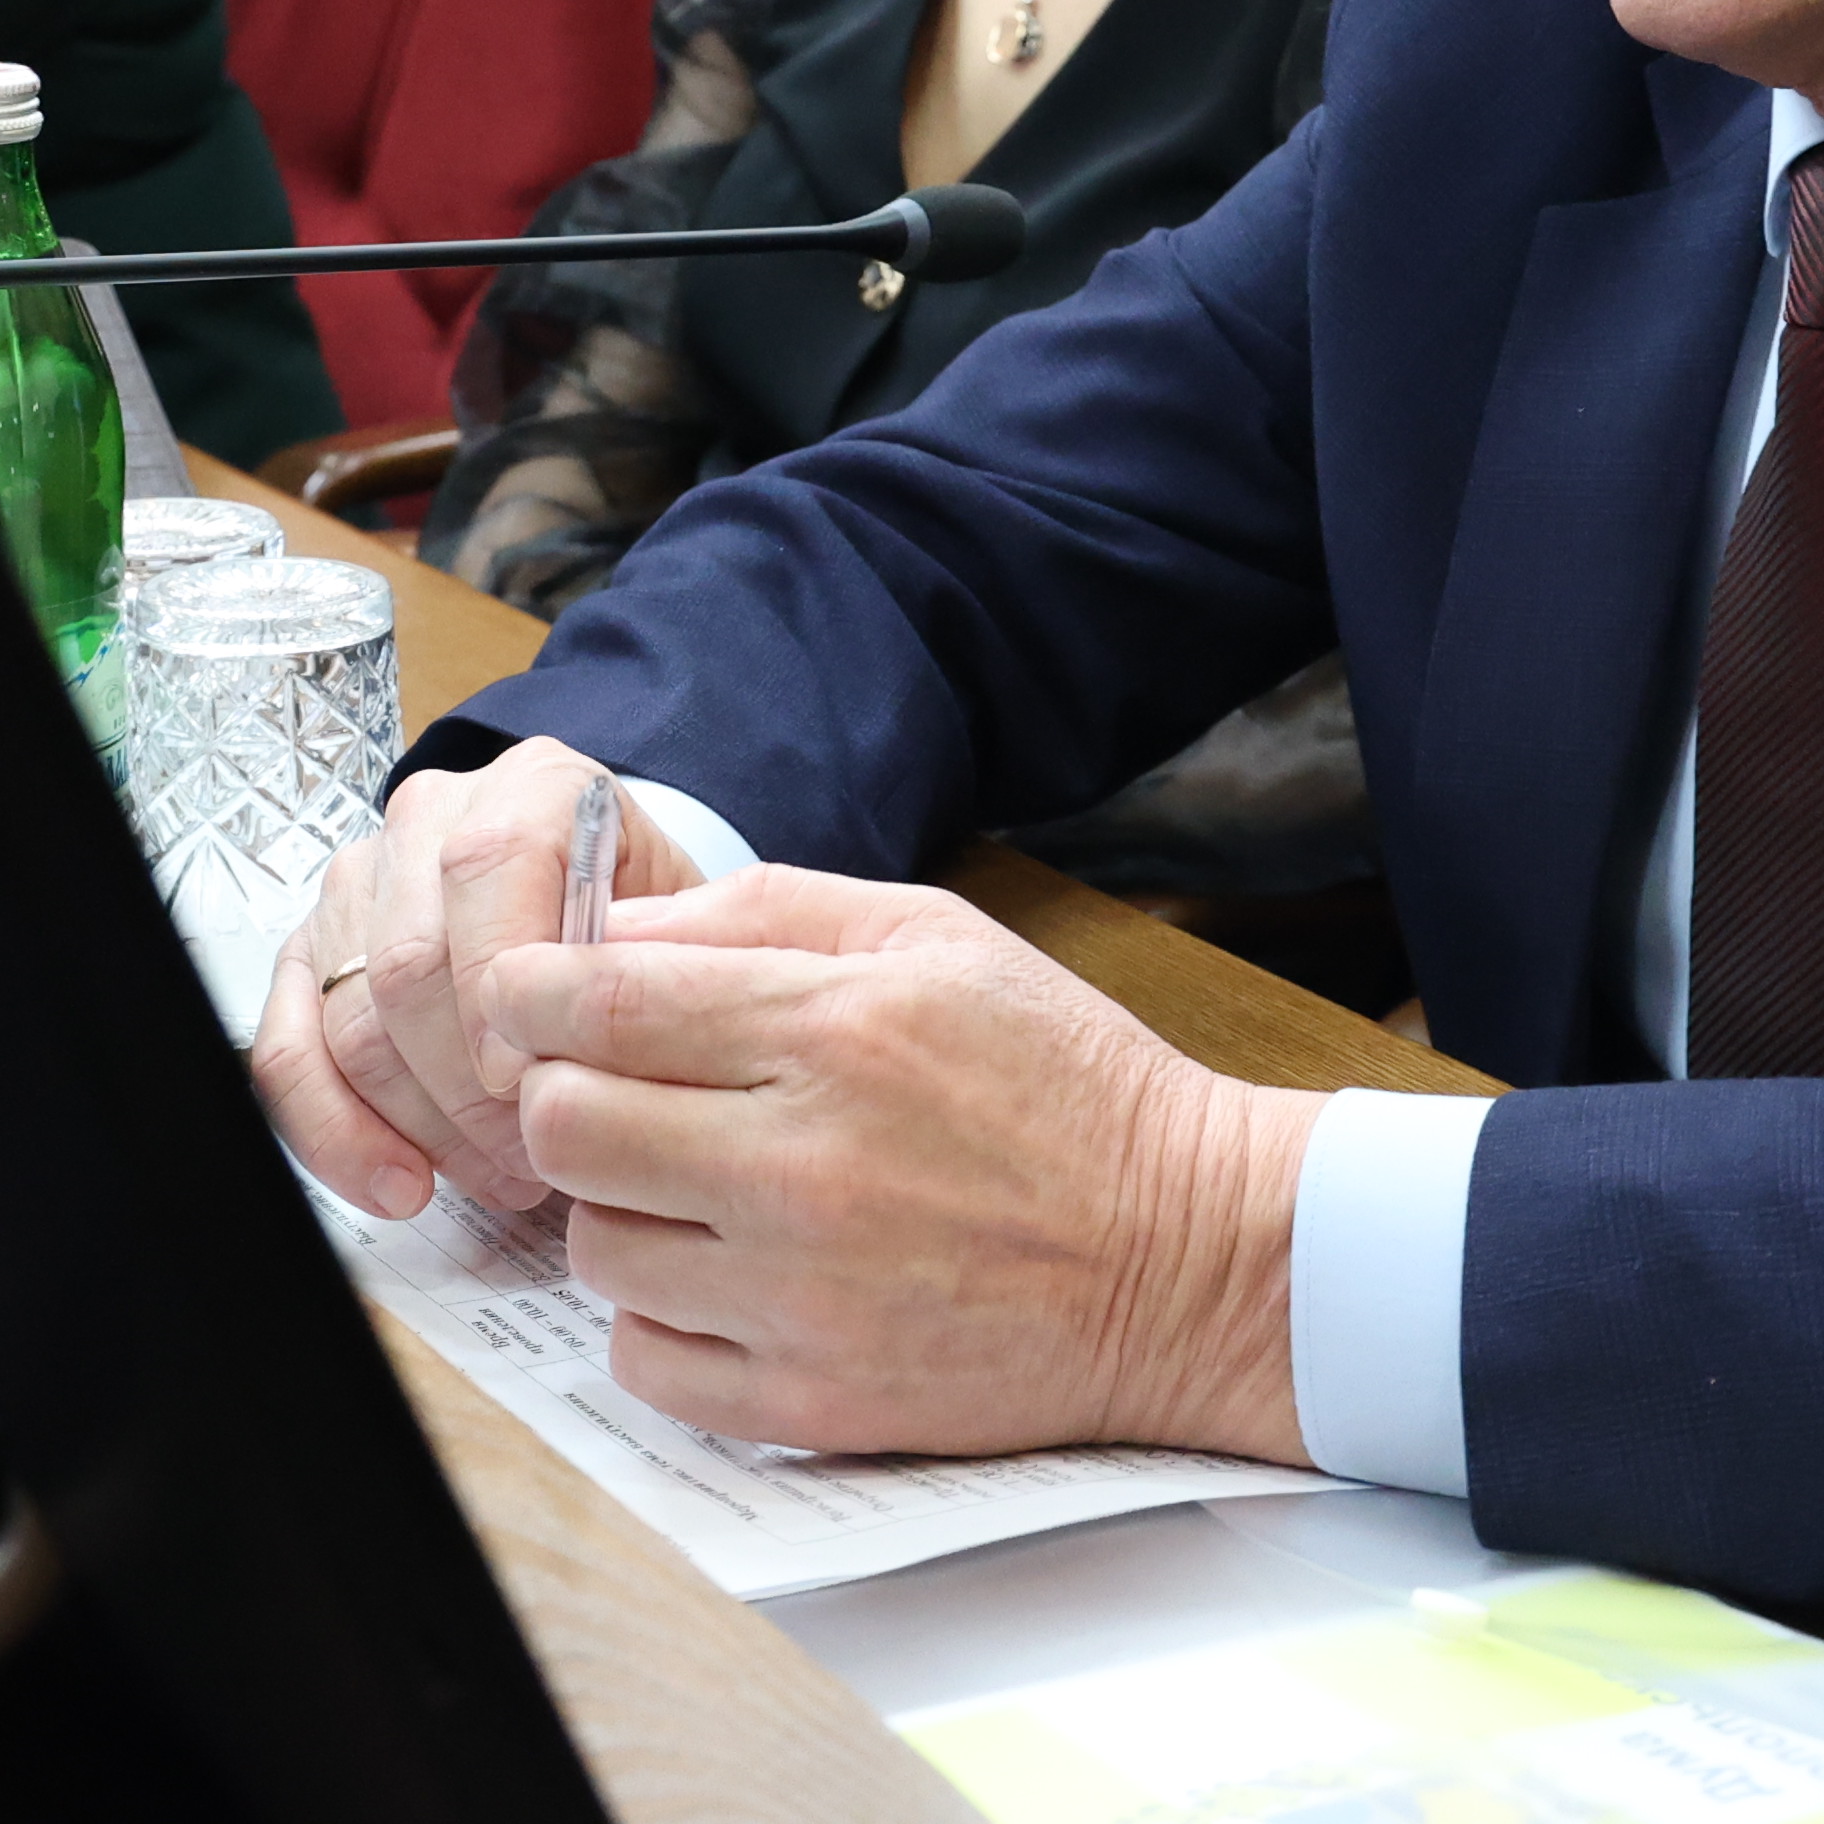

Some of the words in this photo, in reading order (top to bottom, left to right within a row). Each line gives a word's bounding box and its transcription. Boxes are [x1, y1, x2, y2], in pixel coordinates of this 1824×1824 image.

[512, 1296, 549, 1322] 10.00
[470, 1318, 511, 1351] Время
[478, 1306, 545, 1357] проведения
[548, 1323, 587, 1351] 09.00
[562, 1391, 645, 1450] выступления
[642, 1449, 672, 1469] тема
